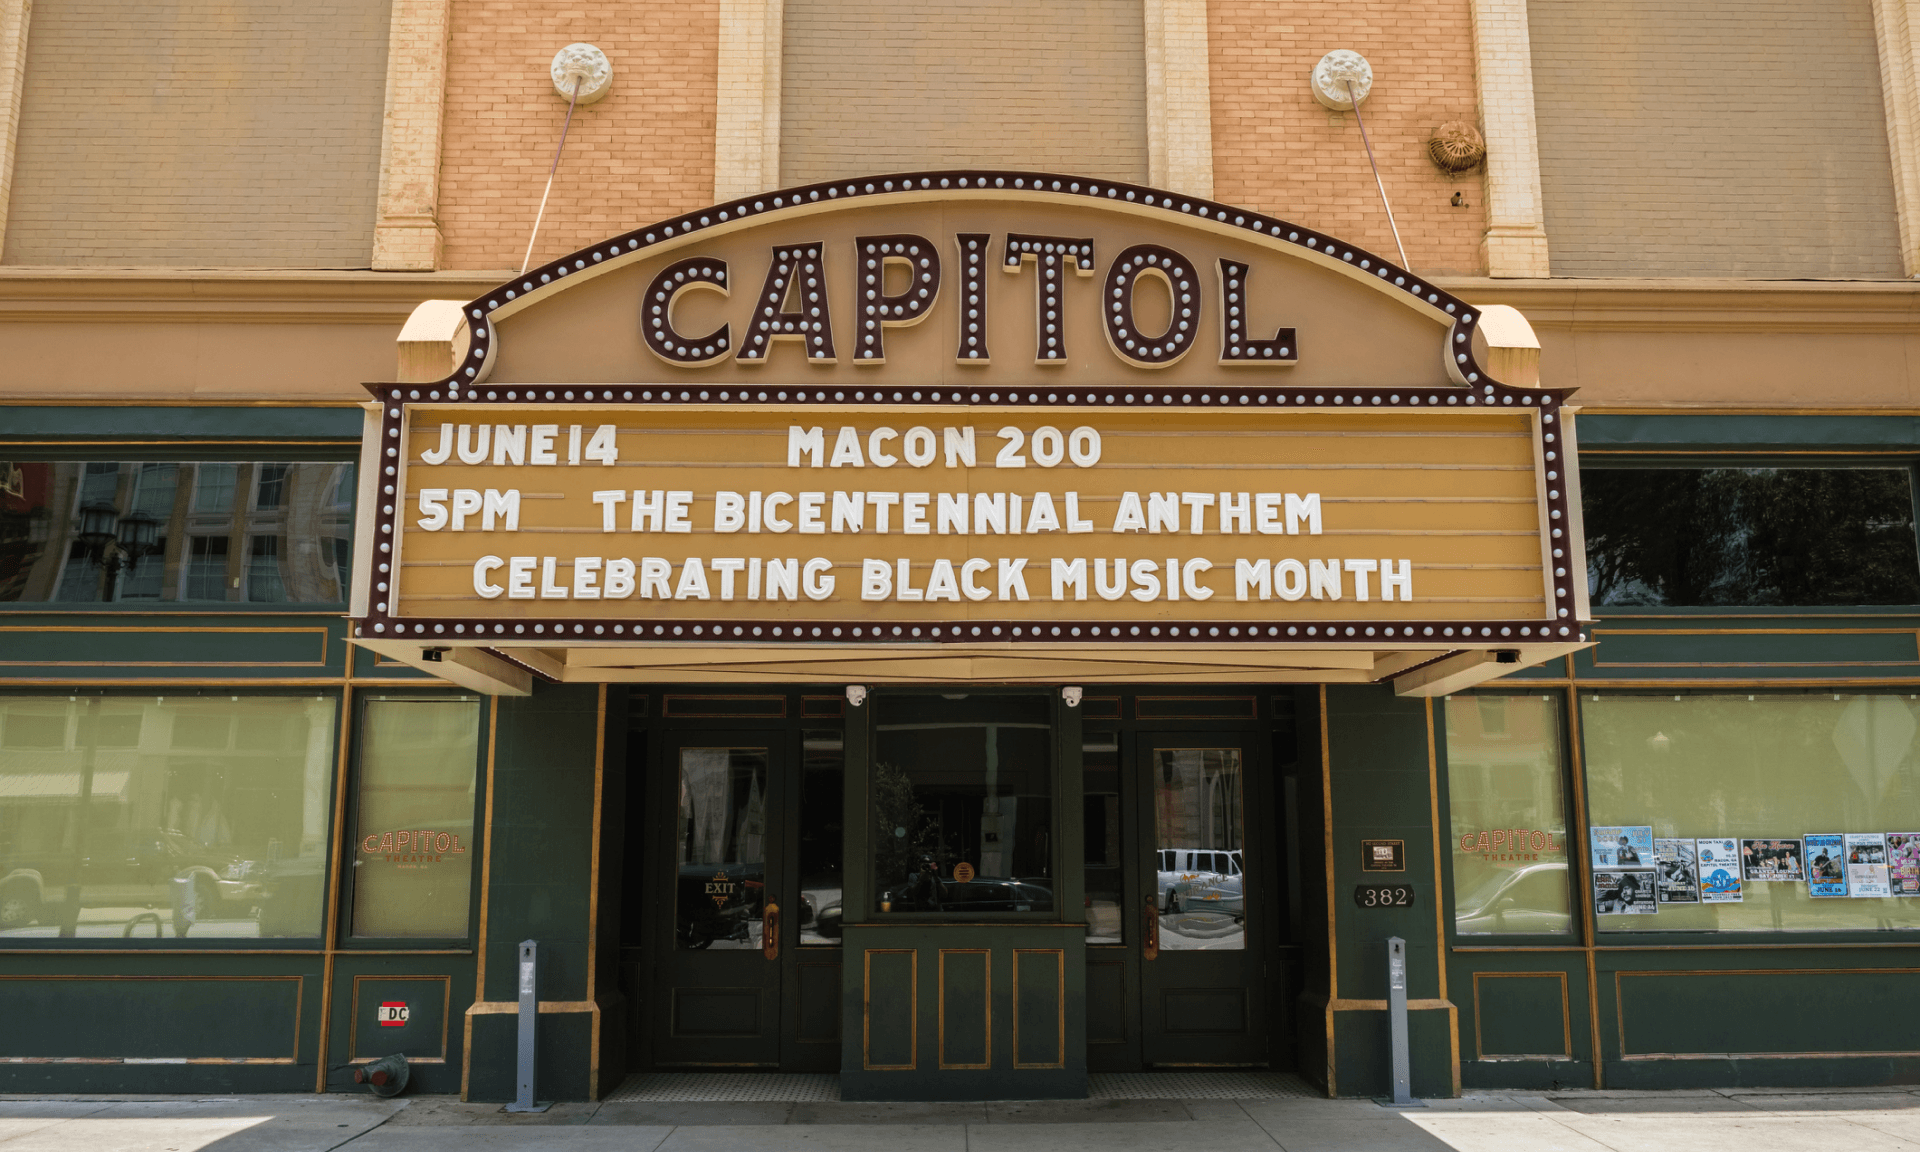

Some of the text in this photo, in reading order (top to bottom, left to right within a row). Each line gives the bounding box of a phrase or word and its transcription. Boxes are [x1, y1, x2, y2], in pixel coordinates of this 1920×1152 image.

[640, 233, 1298, 369] CAPITOL
[420, 423, 558, 466] JUNE
[787, 425, 976, 468] MACON
[995, 426, 1102, 468] 200
[417, 488, 1323, 535] 5PM THE BICENTENNIAL ANTHEM
[473, 555, 1413, 602] CELEBRATING BLACK MUSIC MONTH
[362, 830, 466, 854] CAPITOL
[1460, 829, 1561, 852] CAPITOL
[1483, 853, 1539, 861] THEATRE
[705, 882, 736, 894] EXIT
[1365, 888, 1407, 907] 382
